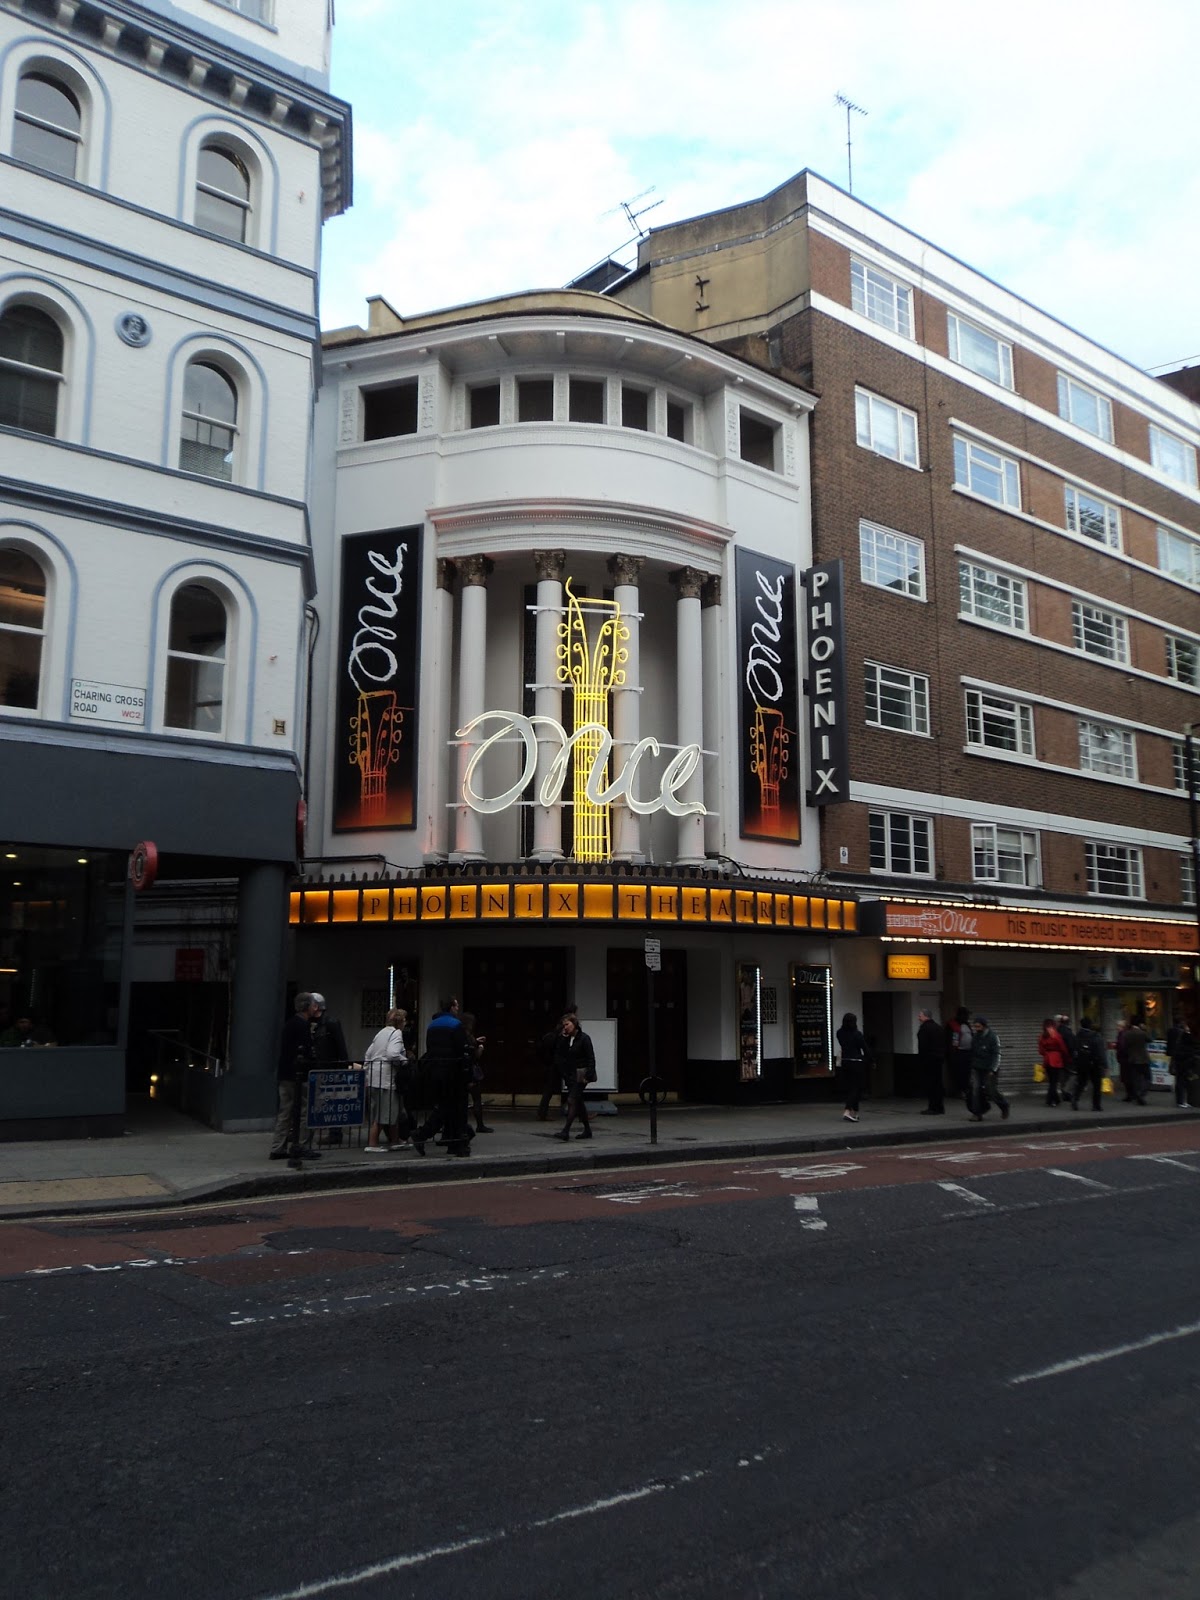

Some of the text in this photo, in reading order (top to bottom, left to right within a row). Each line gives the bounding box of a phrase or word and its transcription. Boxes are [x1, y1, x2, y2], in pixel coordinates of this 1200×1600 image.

[348, 542, 408, 693] Once
[746, 570, 785, 707] Once
[811, 571, 839, 795] PHOENIX
[74, 689, 144, 707] CHARING CROSS
[74, 702, 98, 713] ROAD
[121, 710, 141, 719] WC2
[455, 710, 707, 817] Once
[371, 892, 788, 920] PHOENIX THEATRE
[941, 908, 979, 937] Once
[1007, 916, 1026, 935] his
[1031, 919, 1068, 938] music
[1071, 924, 1113, 941] needed
[1118, 927, 1137, 941] one
[311, 1103, 361, 1114] LOOK BOTH
[323, 1113, 348, 1123] WAYS
